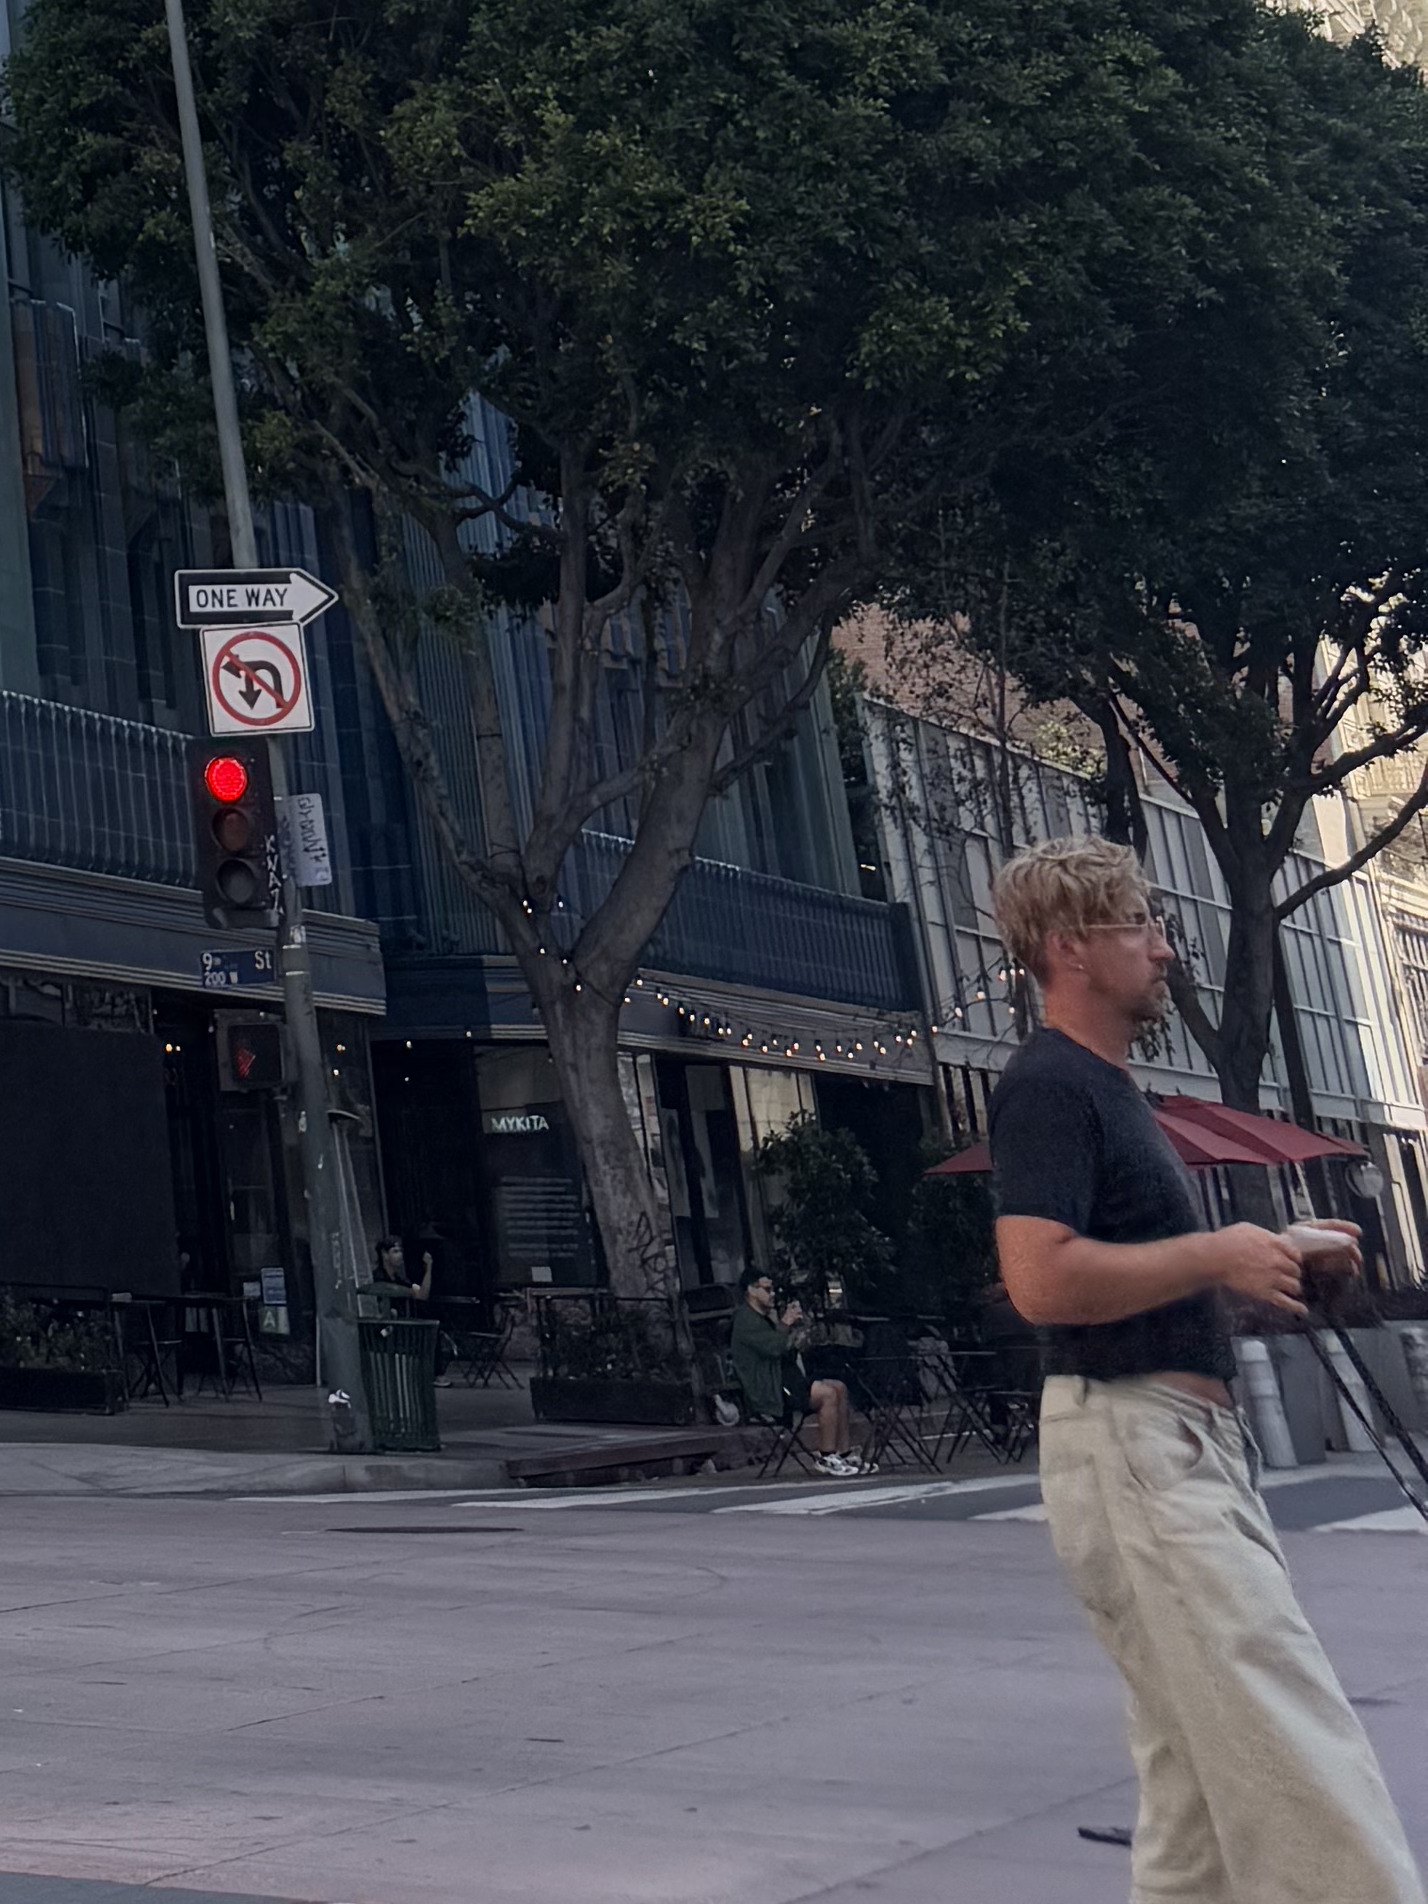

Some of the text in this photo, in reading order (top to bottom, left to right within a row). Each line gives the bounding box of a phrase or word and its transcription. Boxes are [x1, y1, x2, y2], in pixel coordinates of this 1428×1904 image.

[196, 588, 288, 608] ONE WAY
[255, 950, 272, 970] St
[204, 972, 226, 987] 200
[492, 1115, 550, 1132] MYKITA
